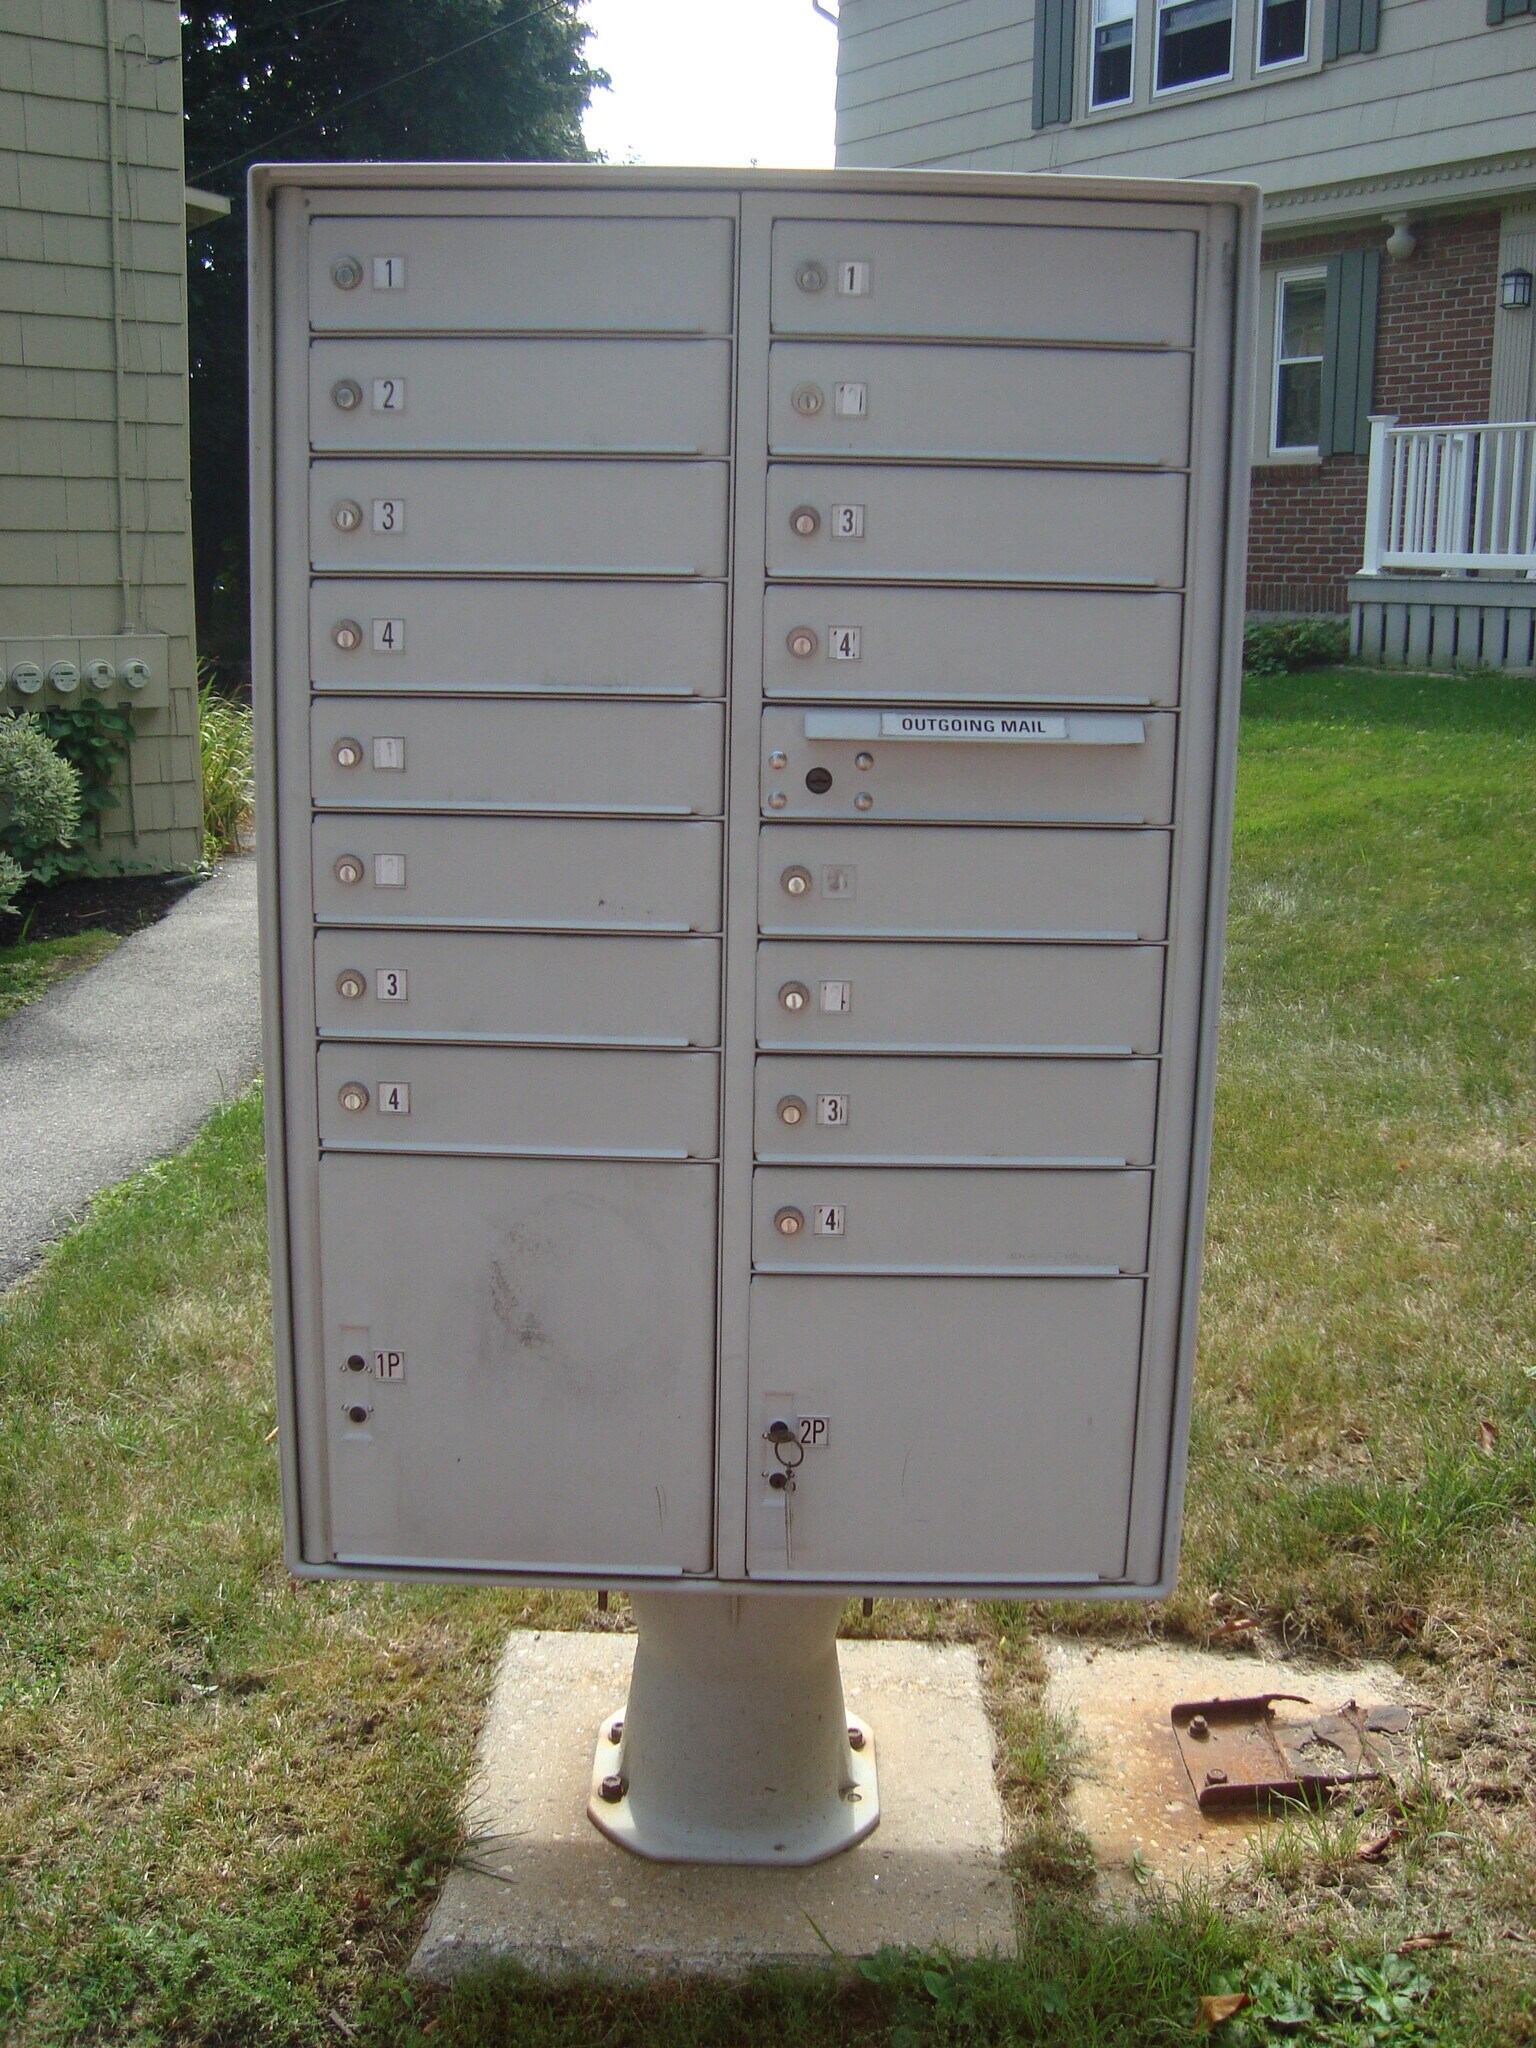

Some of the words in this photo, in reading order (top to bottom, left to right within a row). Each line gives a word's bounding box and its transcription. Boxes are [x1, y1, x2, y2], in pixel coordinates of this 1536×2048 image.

[385, 259, 393, 287] 1
[847, 266, 855, 290] 1
[383, 381, 396, 409] 2
[383, 502, 395, 530] 3
[842, 509, 853, 532] 3
[382, 621, 395, 649] 4
[840, 633, 851, 657] 4
[901, 718, 995, 732] OUTGOING
[1001, 719, 1046, 734] MAIL
[387, 974, 397, 996] 3
[389, 1088, 399, 1110] 4
[827, 1099, 838, 1122] 3
[825, 1208, 836, 1231] 4
[376, 1353, 400, 1378] 1P
[800, 1419, 826, 1444] 2P
